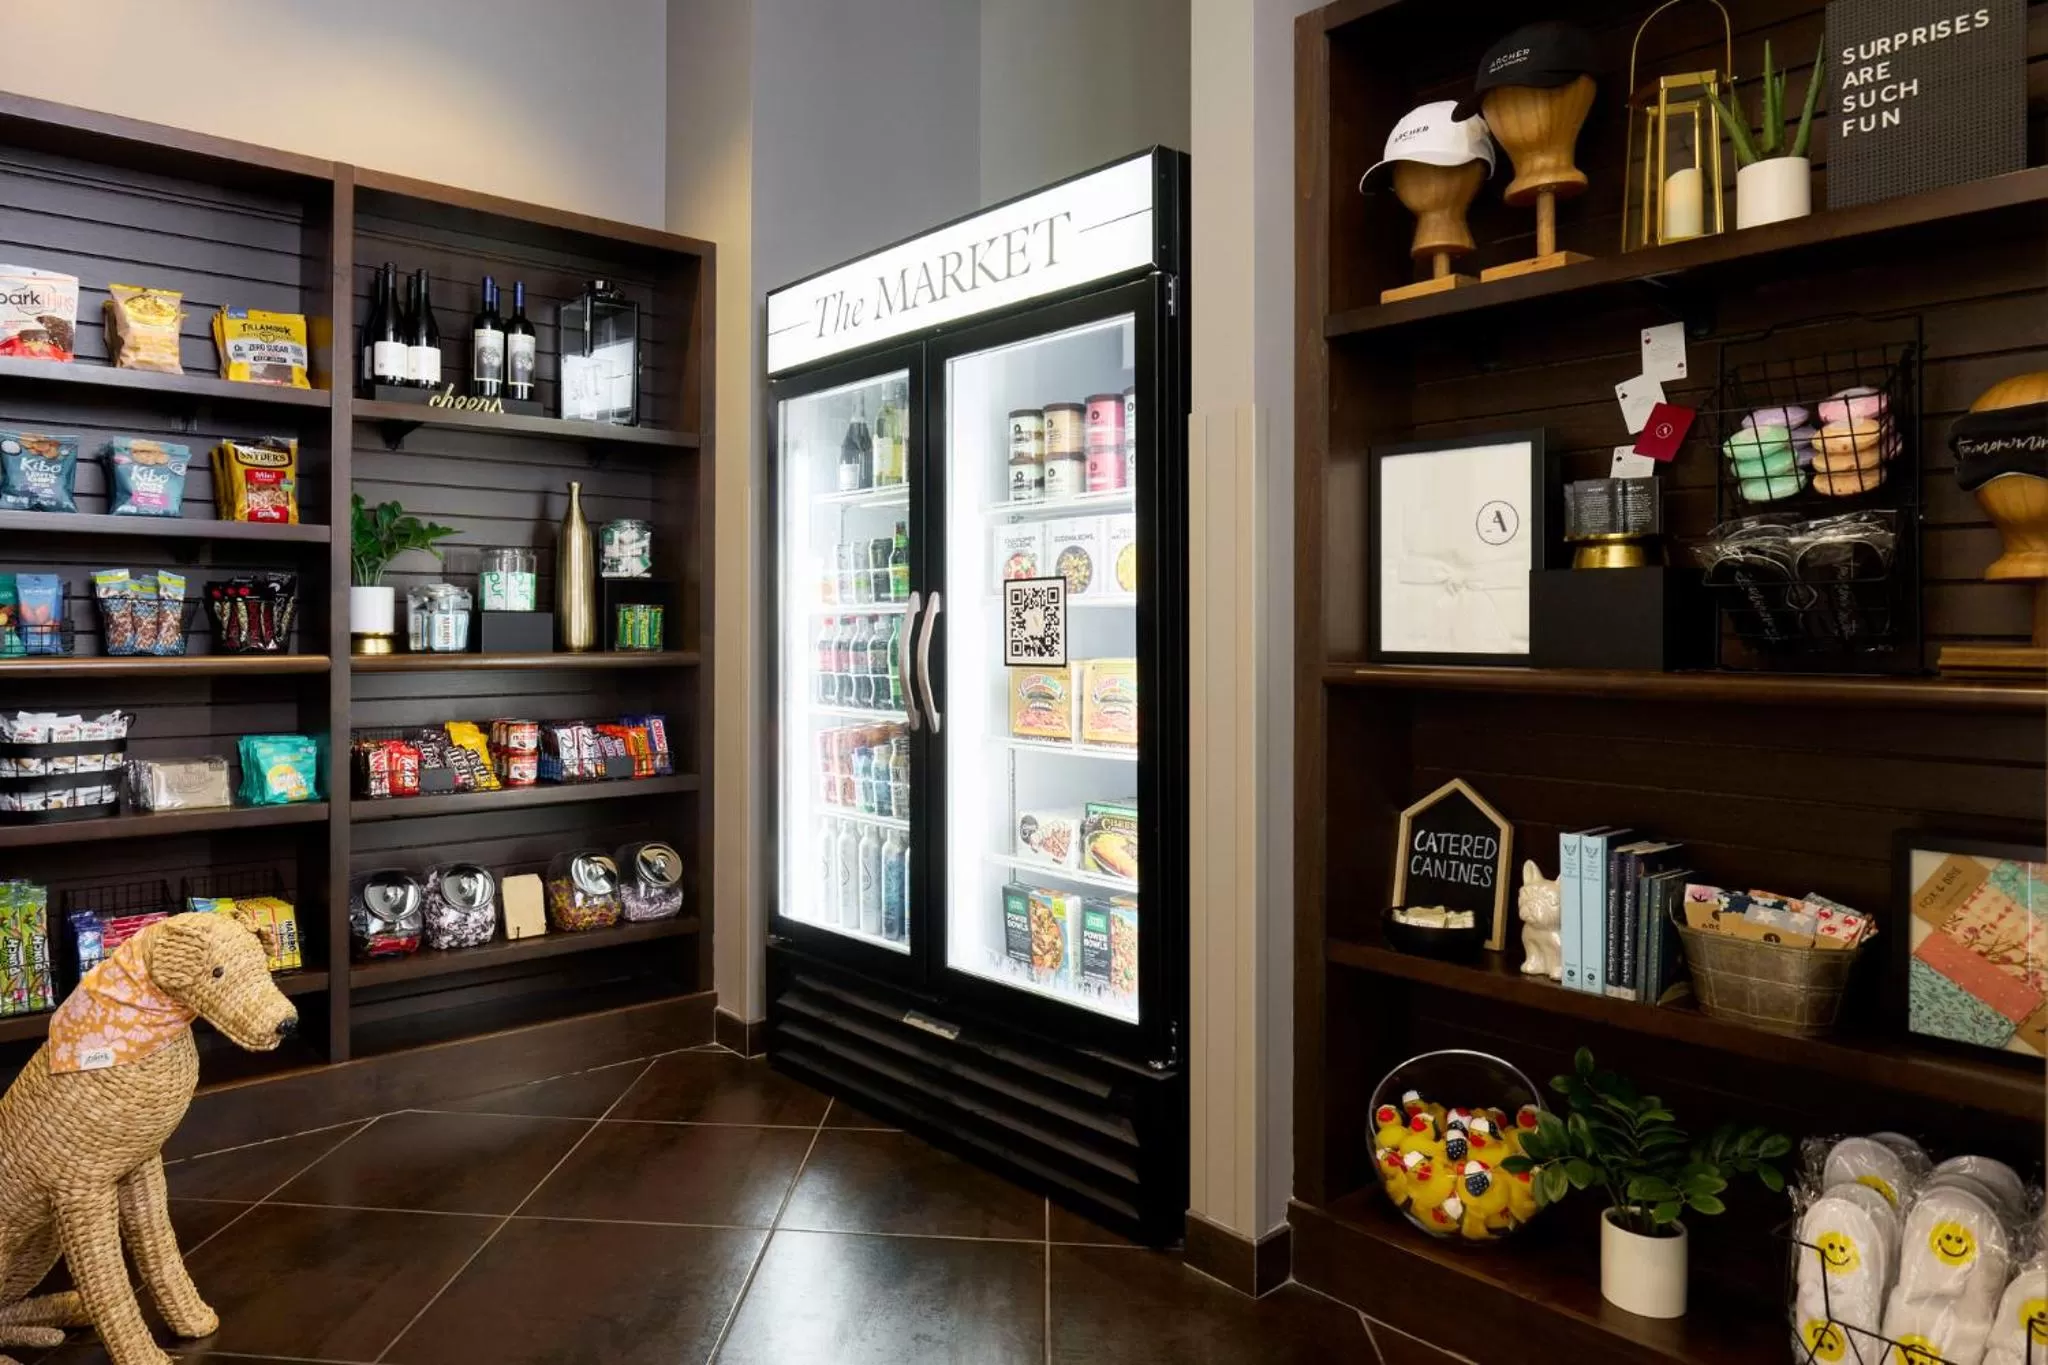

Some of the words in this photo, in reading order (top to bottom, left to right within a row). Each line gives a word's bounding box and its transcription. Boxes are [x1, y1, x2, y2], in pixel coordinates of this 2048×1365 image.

[1842, 9, 1990, 65] SURPRISES
[1488, 48, 1530, 69] ARCHER
[1842, 61, 1892, 90] ARE
[1842, 78, 1919, 113] SUCH
[1394, 125, 1429, 143] ARCHER
[1842, 107, 1901, 137] FUN
[815, 291, 866, 339] The
[874, 211, 1073, 320] MARKET
[242, 322, 292, 337] TILLAMOOK
[429, 383, 504, 414] cheers
[20, 457, 61, 474] Kibo
[130, 465, 170, 483] Kibo
[1413, 829, 1498, 861] CATERED
[1410, 854, 1494, 888] CANINES
[285, 920, 297, 952] HARIBO
[8, 937, 22, 977] PUNCH
[33, 935, 45, 973] PUNCH
